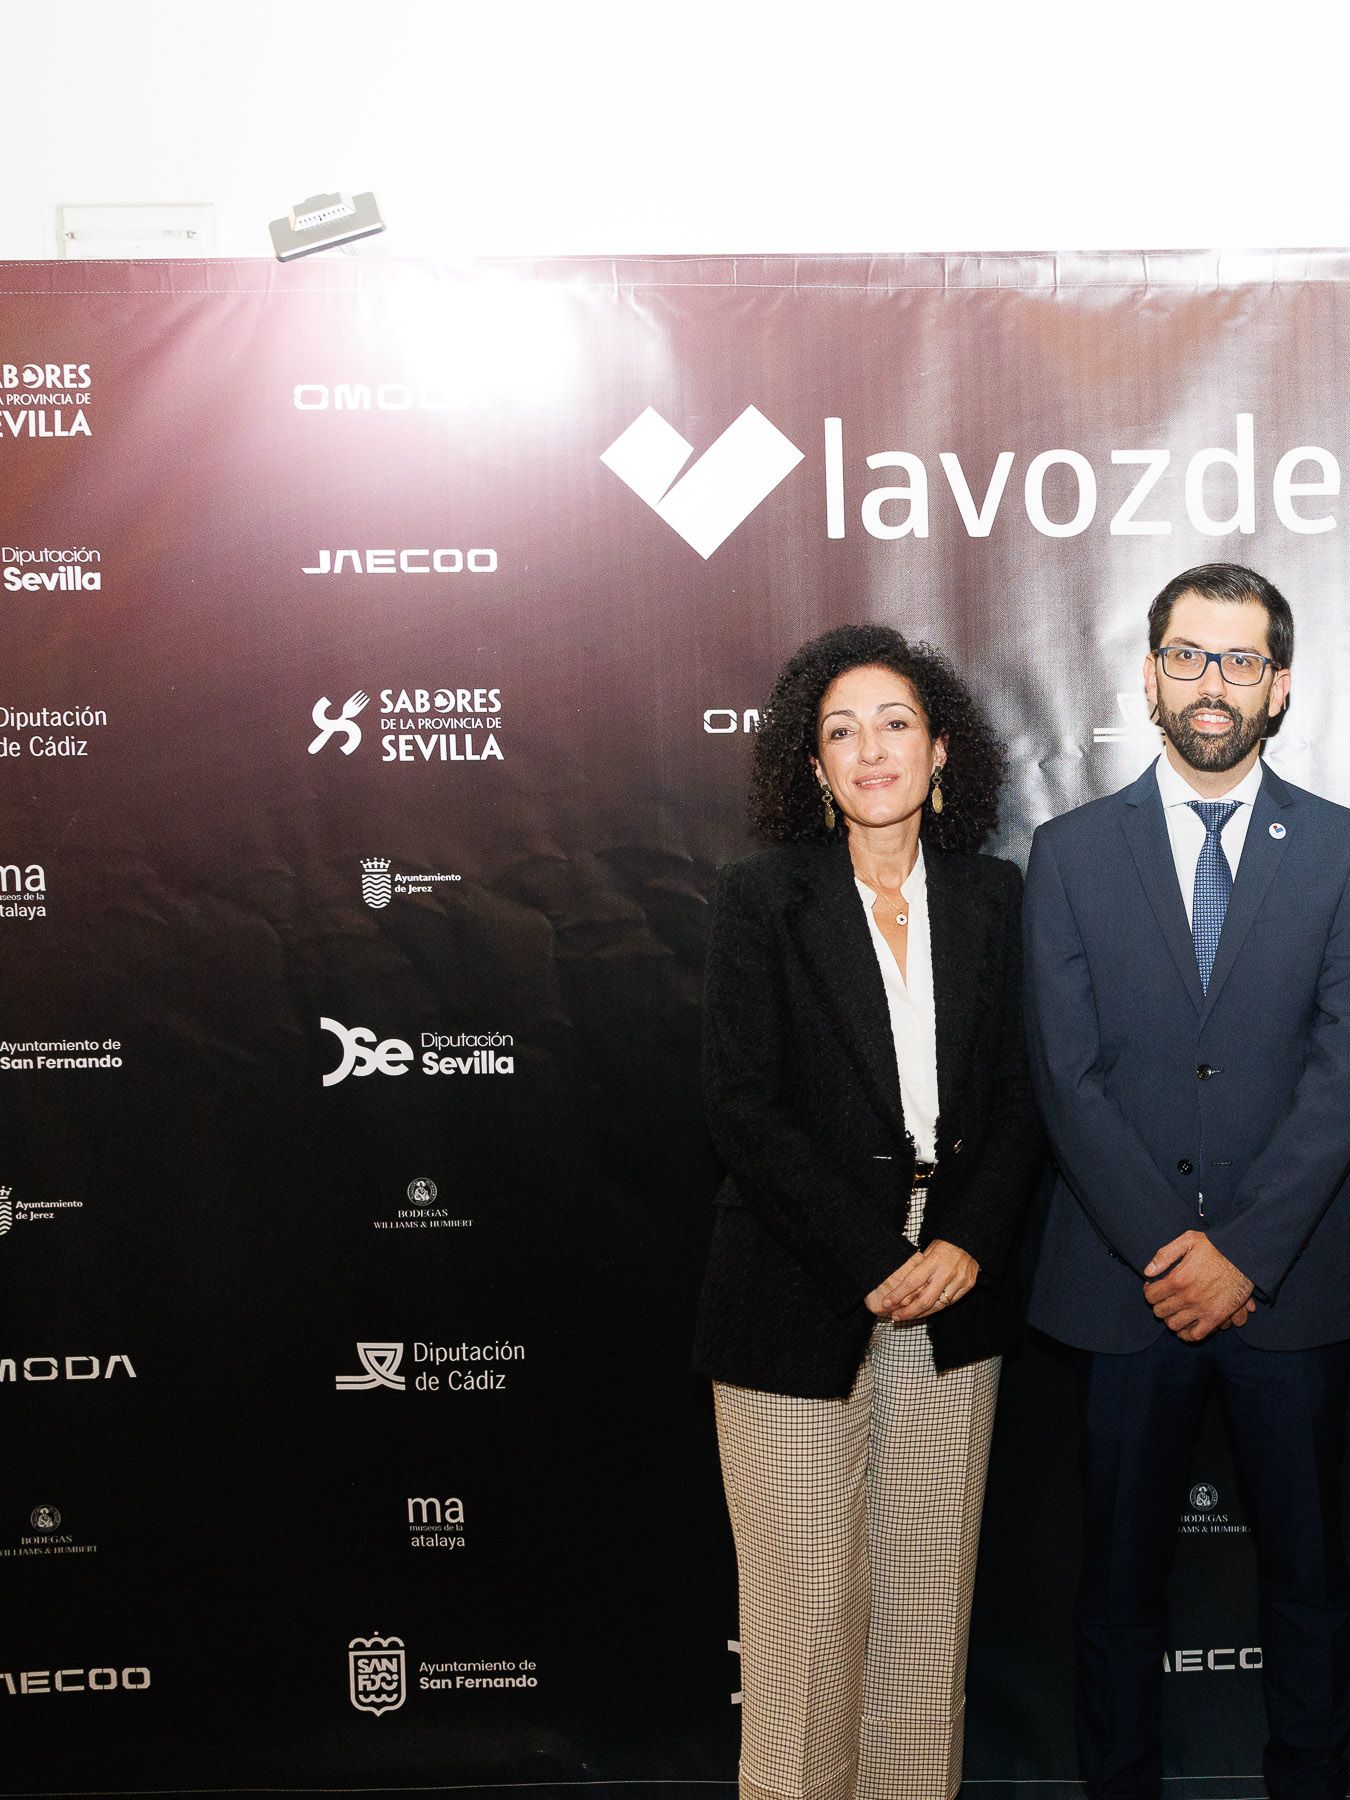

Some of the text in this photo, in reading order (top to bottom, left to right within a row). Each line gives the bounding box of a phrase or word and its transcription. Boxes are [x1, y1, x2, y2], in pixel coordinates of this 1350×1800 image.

[0, 364, 91, 388] BORES
[7, 394, 73, 405] PROVINCIA
[76, 393, 91, 404] DE
[0, 409, 92, 437] VILLA
[2, 547, 100, 565] Diputación
[302, 549, 497, 573] JAECOO
[4, 567, 101, 591] Sevilla
[380, 689, 501, 713] SABORES
[381, 717, 502, 729] DE LA PROVINCIA DE
[30, 736, 88, 756] Cádiz
[382, 733, 504, 761] SEVILLA
[395, 873, 461, 882] Ayuntamiento
[395, 884, 432, 894] de Jerez
[0, 1039, 121, 1055] Ayuntamiento de
[422, 1032, 513, 1049] Diputación
[0, 1055, 122, 1069] San Fernando
[422, 1051, 514, 1075] Sevilla
[16, 1200, 83, 1210] Ayuntamiento
[399, 1209, 448, 1217] BODEGAS
[30, 1212, 54, 1221] Jerez
[414, 1341, 524, 1364] Diputación
[416, 1370, 505, 1390] de Cádiz
[408, 1498, 464, 1523] ma
[1200, 1525, 1209, 1534] &
[1209, 1525, 1251, 1534] HUMBER
[22, 1536, 72, 1544] BODEGAS
[412, 1534, 465, 1550] atalaya
[43, 1545, 52, 1555] &
[53, 1544, 99, 1555] HUMBERT
[420, 1660, 536, 1675] Ayuntamiento de
[420, 1675, 537, 1690] San Fernando
